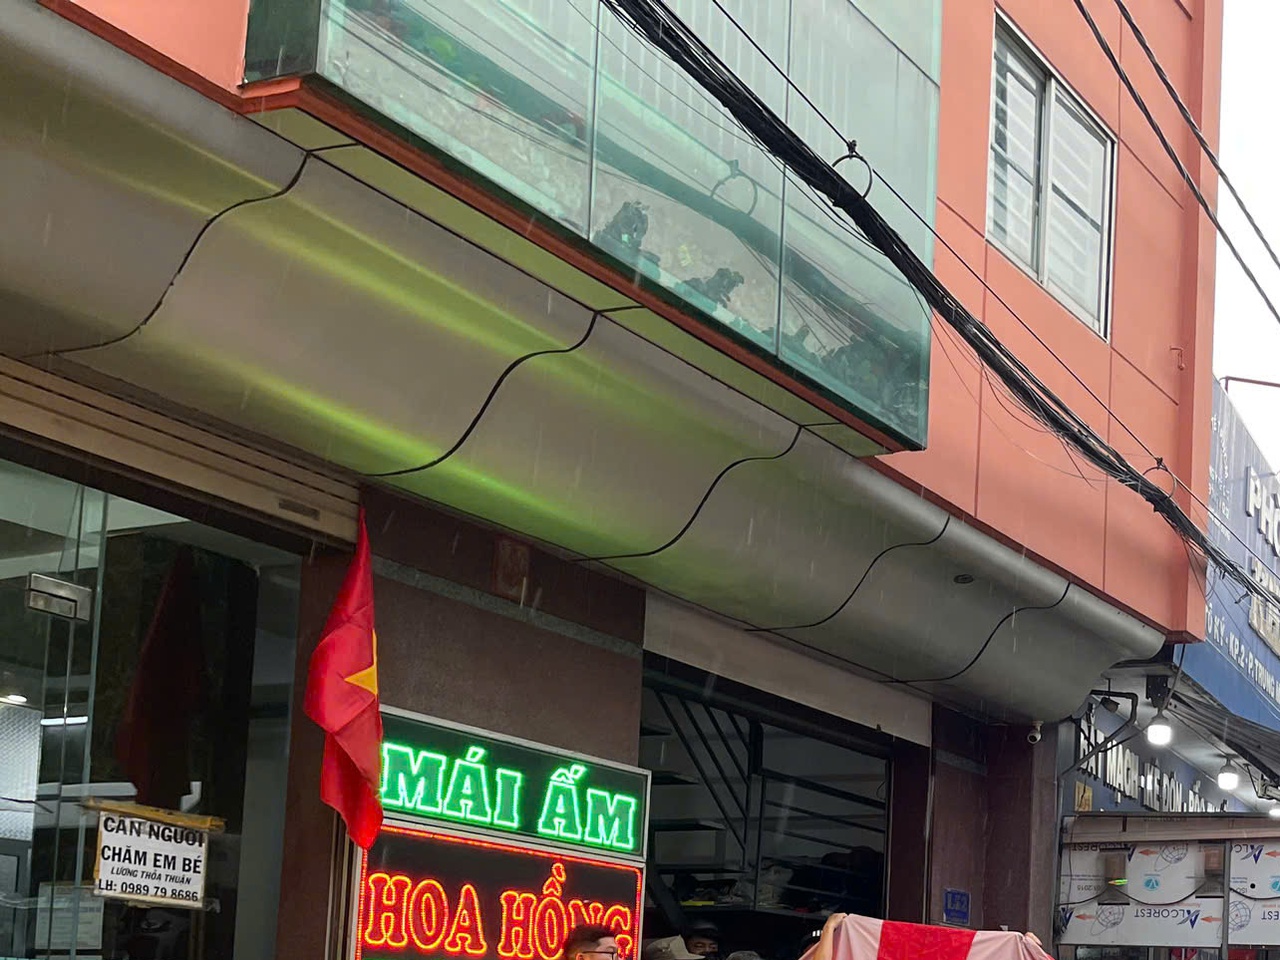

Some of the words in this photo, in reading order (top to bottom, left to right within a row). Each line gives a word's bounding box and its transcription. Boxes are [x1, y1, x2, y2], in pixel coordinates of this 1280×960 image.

[1213, 615, 1226, 646] KÝ
[381, 741, 523, 829] MÁI
[537, 763, 638, 850] ẤM
[101, 844, 147, 867] CHĂM
[153, 853, 176, 871] EM
[182, 855, 202, 874] BÉ
[98, 878, 117, 892] LH:
[121, 881, 149, 896] 0989
[153, 886, 167, 898] 79
[171, 888, 198, 902] 8686
[364, 872, 488, 955] HOA
[1134, 908, 1200, 929] ALCOREST
